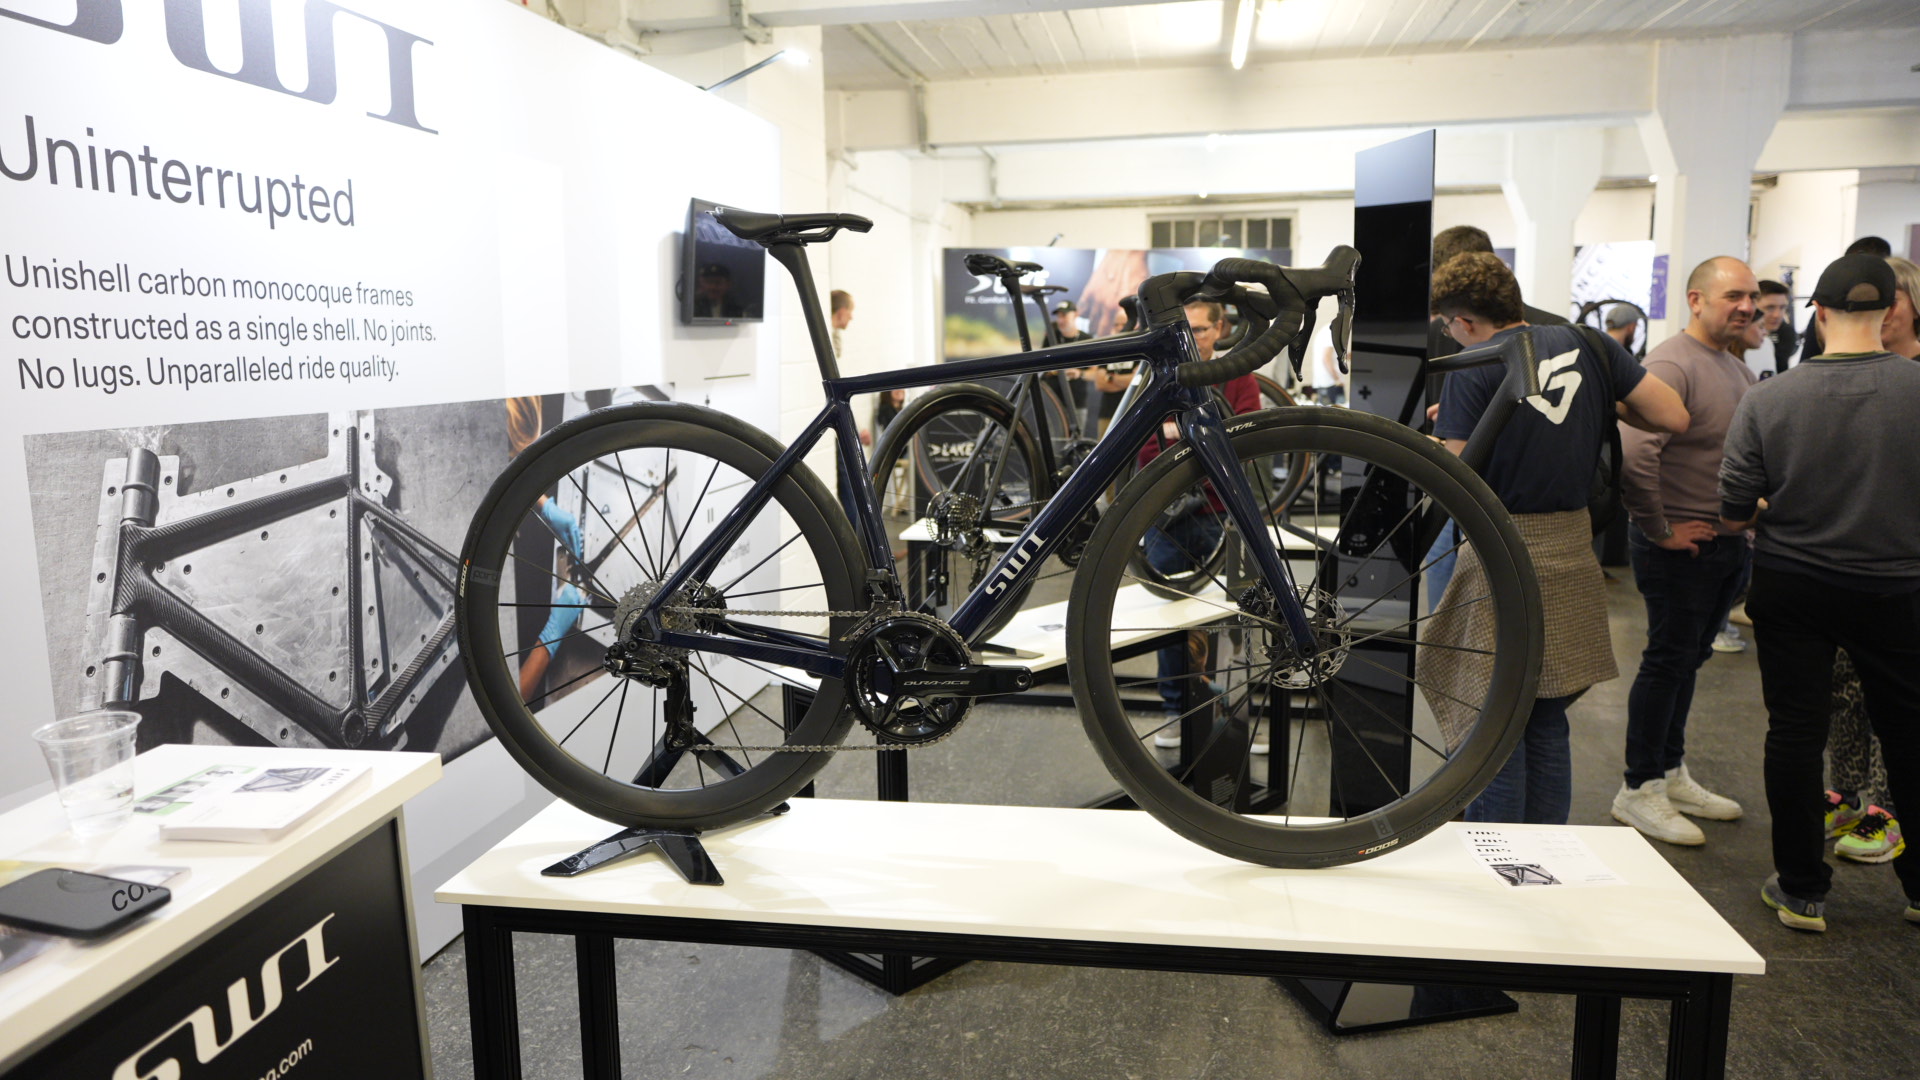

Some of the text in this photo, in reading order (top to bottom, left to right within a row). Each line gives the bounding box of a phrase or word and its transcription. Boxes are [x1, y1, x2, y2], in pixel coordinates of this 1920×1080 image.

[0, 114, 355, 230] Uninterrupted
[5, 254, 414, 309] Unishell carbon monocoque frames
[12, 313, 437, 348] constructed as a single shell. No joints.
[18, 354, 399, 395] No lugs. Unparalleled ride quality.
[985, 527, 1049, 600] SWI
